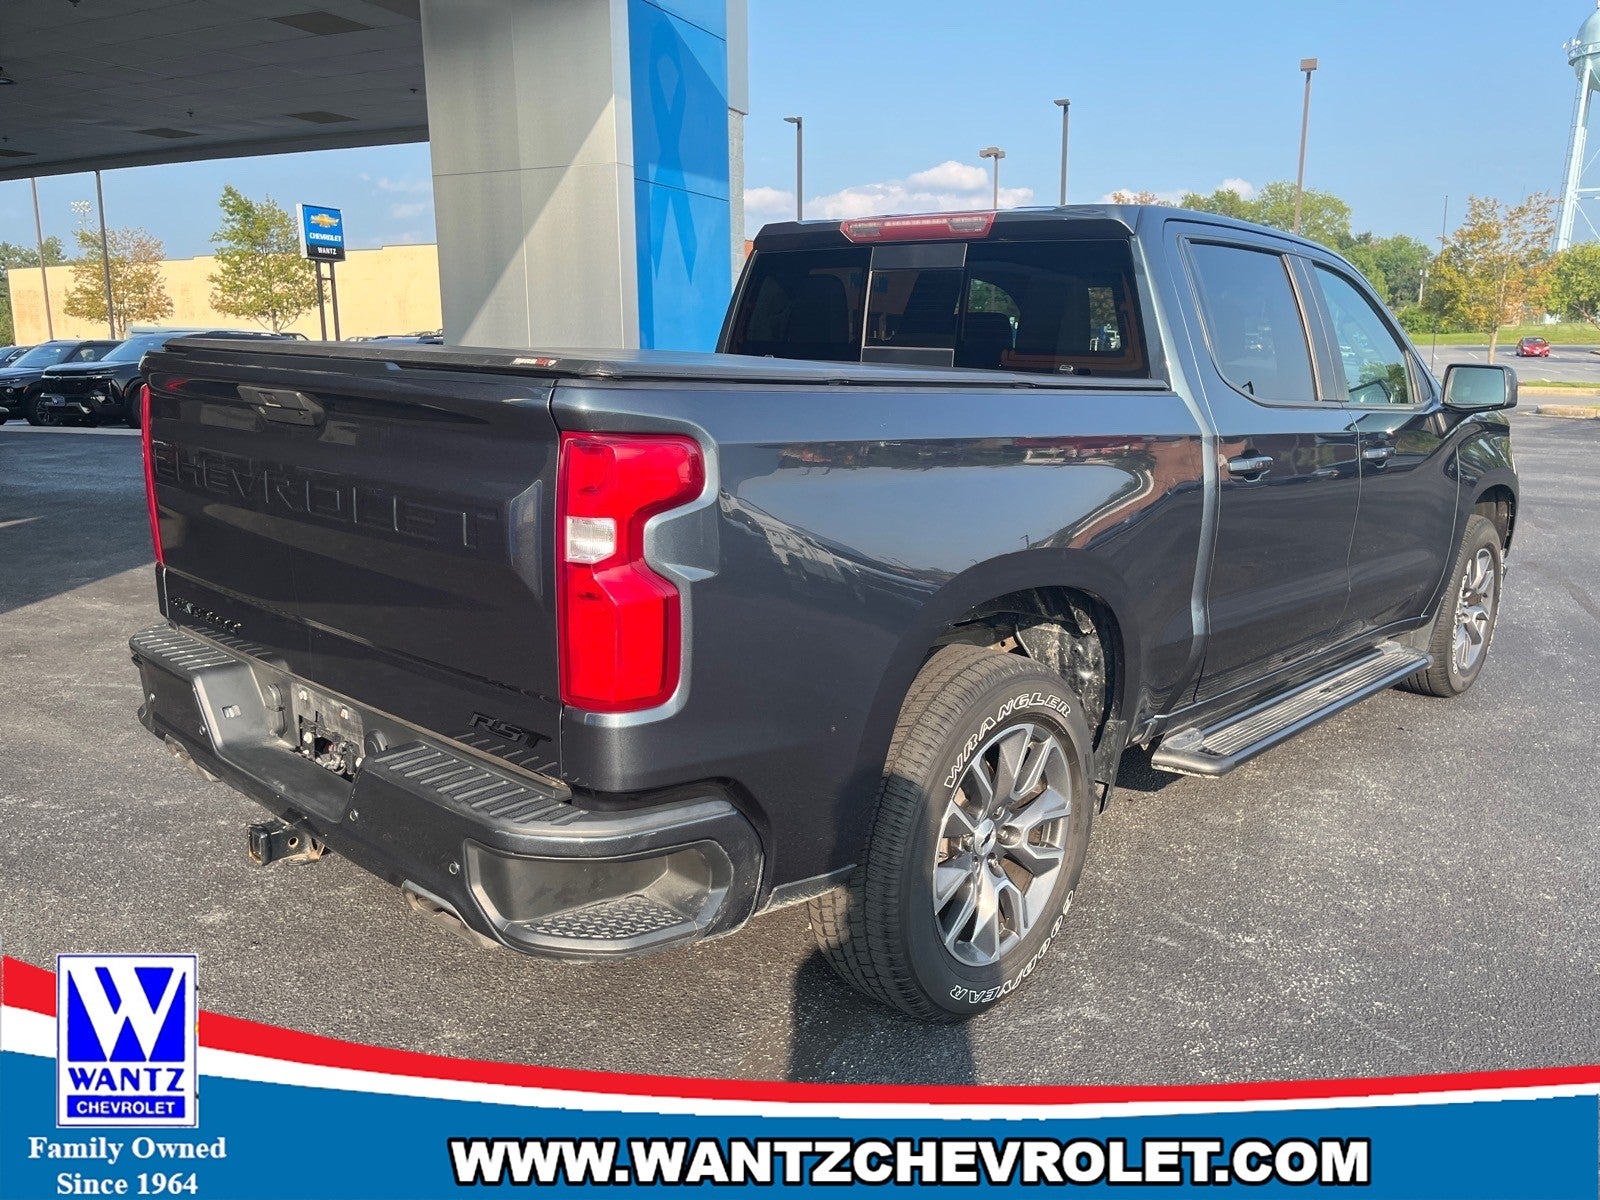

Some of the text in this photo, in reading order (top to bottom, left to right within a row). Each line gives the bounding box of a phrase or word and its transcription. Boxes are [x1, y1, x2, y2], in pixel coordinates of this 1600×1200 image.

[309, 232, 342, 242] CHEVROLET
[317, 246, 338, 255] WANTZ
[152, 440, 498, 548] CHEVROLET
[468, 711, 552, 749] RST
[944, 692, 1071, 789] WRANGLER
[949, 889, 1074, 1004] GOODYEAR
